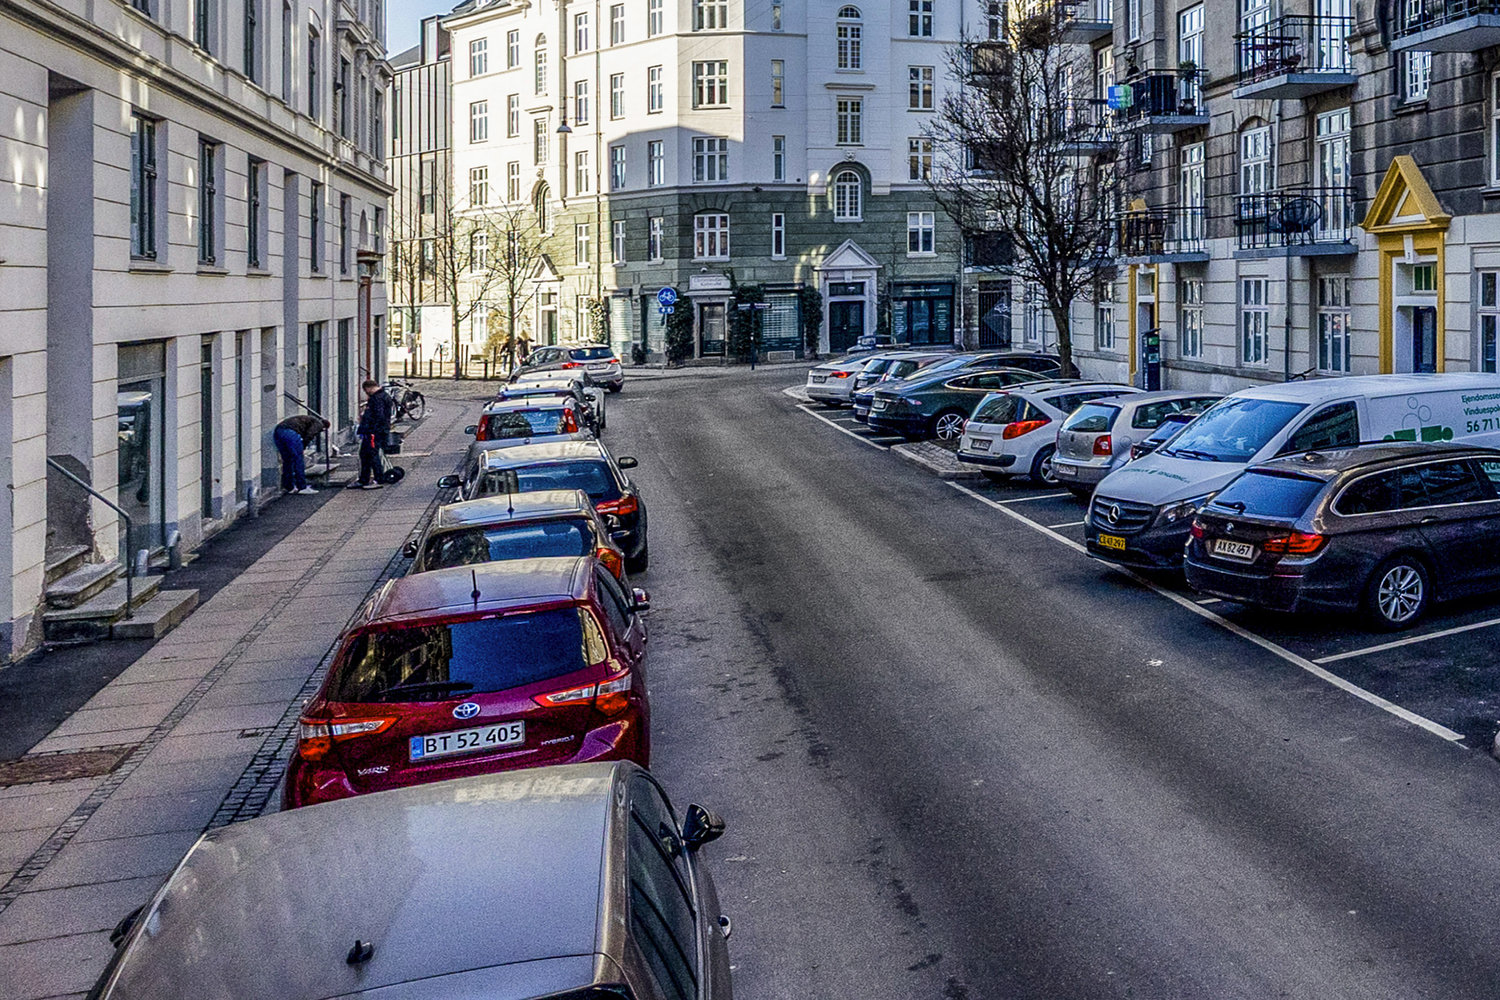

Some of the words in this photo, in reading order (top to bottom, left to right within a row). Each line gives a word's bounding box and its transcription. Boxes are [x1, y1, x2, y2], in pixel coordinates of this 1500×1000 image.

[1466, 420, 1480, 433] 56
[1482, 418, 1493, 431] 71
[1216, 541, 1227, 552] AX
[1227, 542, 1237, 553] 82
[1237, 544, 1251, 555] 457
[425, 736, 451, 753] BT
[457, 732, 480, 748] 52
[485, 725, 521, 743] 405
[357, 765, 390, 776] YARIS
